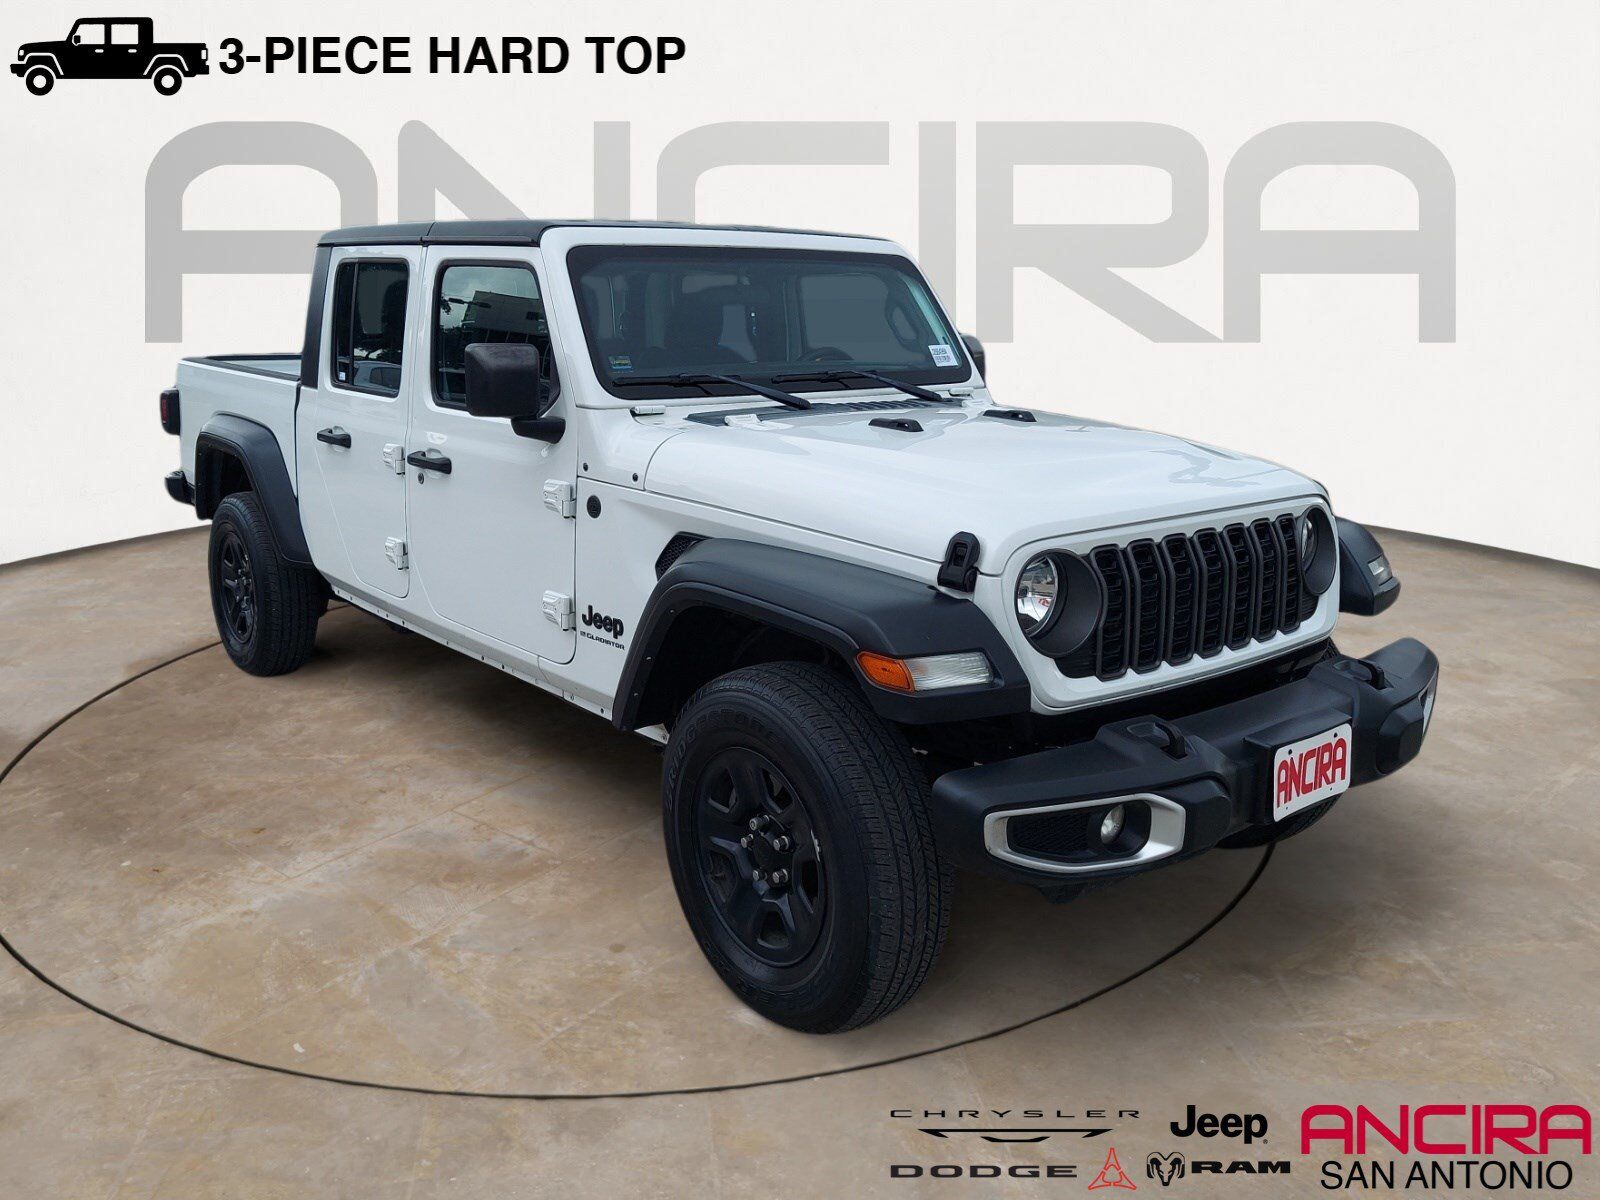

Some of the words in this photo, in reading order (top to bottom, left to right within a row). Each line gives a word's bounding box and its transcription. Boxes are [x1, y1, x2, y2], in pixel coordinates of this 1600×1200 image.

[581, 604, 624, 639] Jeep
[586, 632, 625, 651] GLADIATOR
[1276, 737, 1347, 808] ANCIRA
